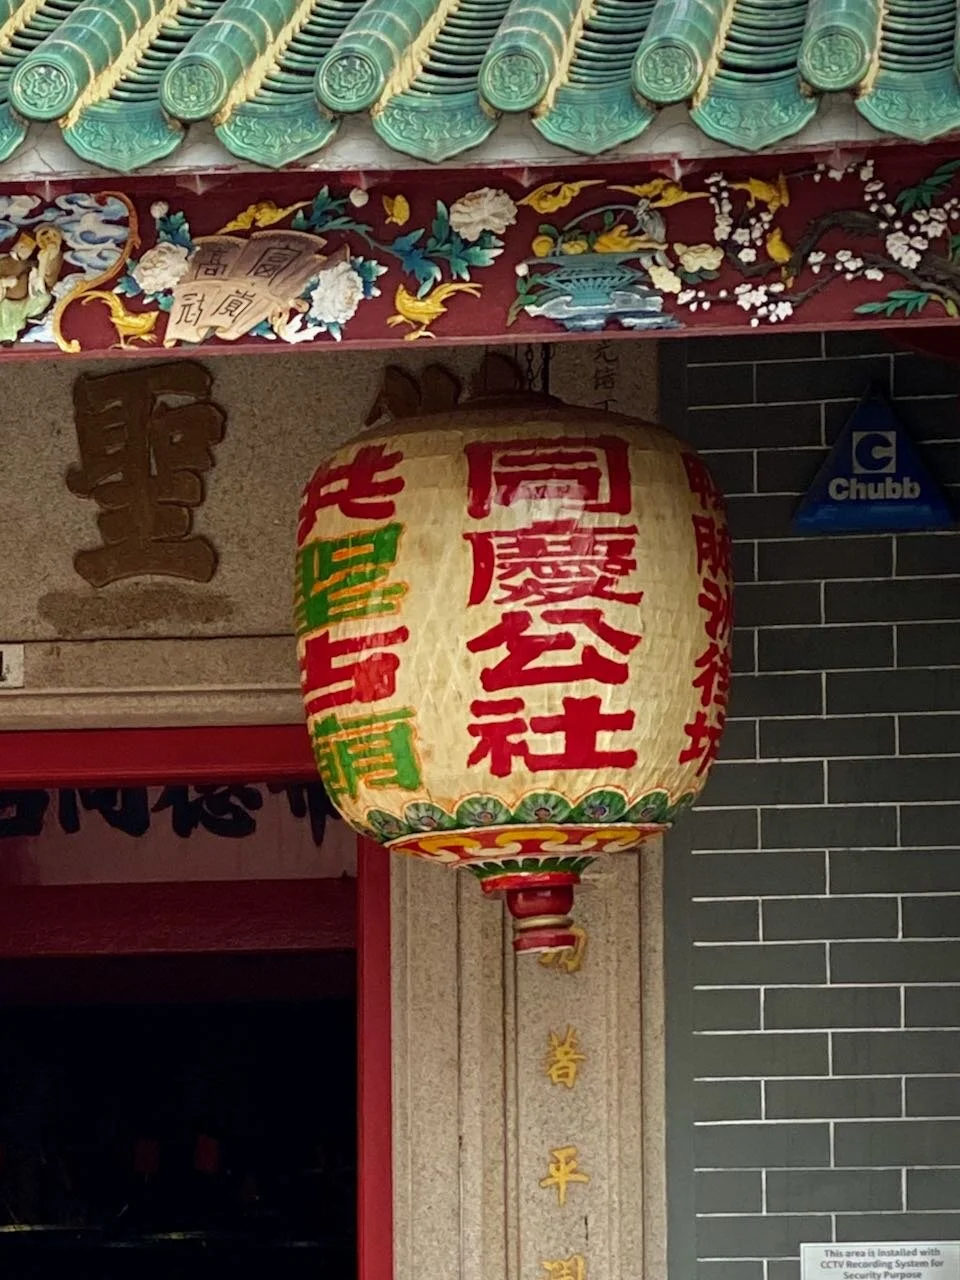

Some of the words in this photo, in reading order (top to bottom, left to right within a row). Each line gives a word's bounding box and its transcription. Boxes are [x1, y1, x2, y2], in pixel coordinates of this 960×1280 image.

[828, 476, 922, 501] Chubb
[462, 435, 644, 776] 同慶公社
[824, 1249, 843, 1257] This
[868, 1249, 875, 1257] is
[878, 1248, 917, 1257] installed
[920, 1247, 940, 1256] with
[820, 1261, 844, 1269] CCTV
[846, 1259, 893, 1270] Recording
[895, 1259, 929, 1269] System
[931, 1259, 944, 1267] for
[843, 1271, 882, 1280] Security
[883, 1271, 922, 1280] Purpose
